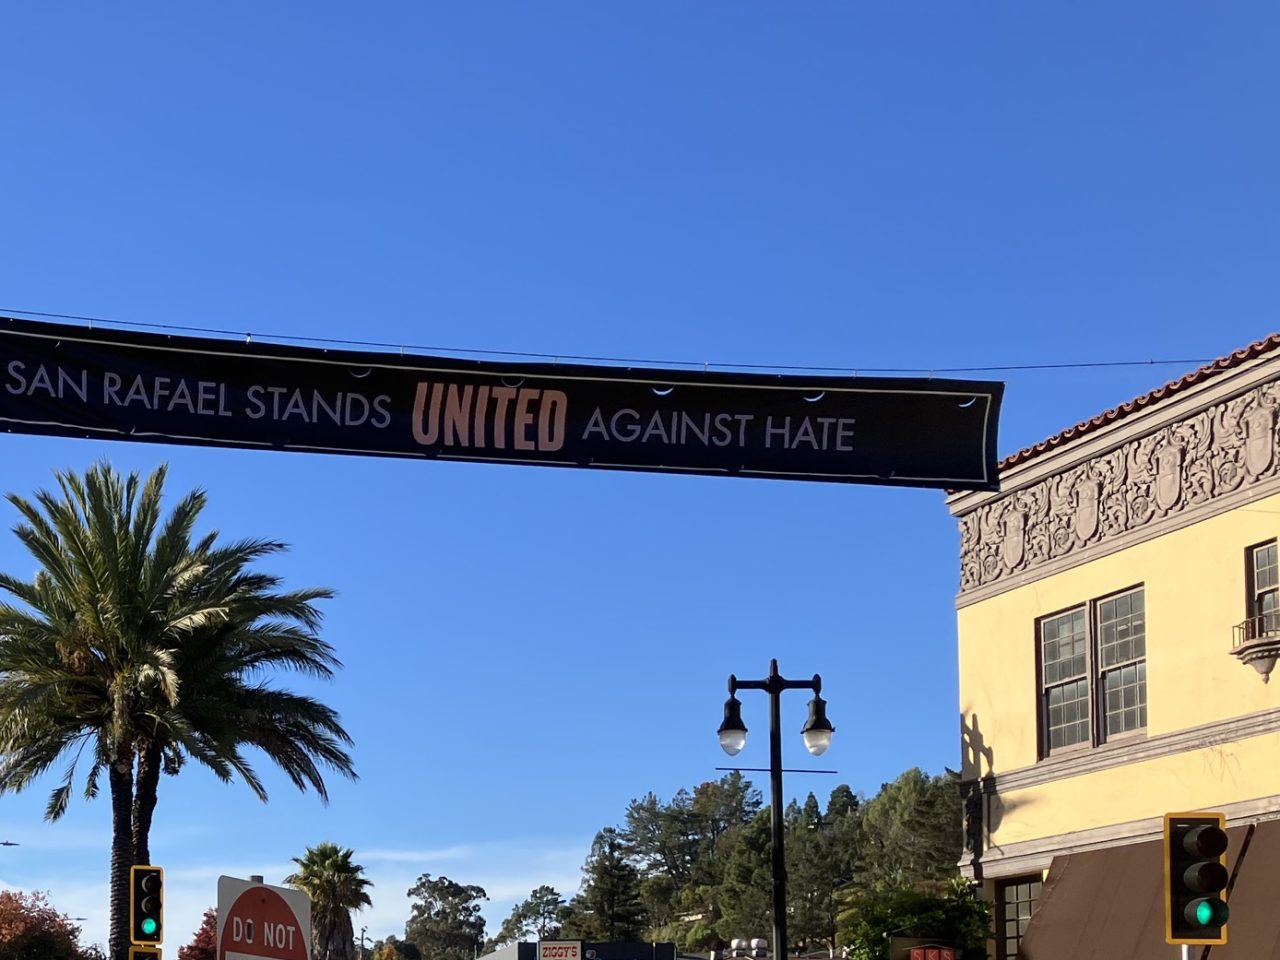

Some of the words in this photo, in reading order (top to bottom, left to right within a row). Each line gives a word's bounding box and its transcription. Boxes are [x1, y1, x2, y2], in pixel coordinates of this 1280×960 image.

[5, 360, 89, 404] SAN
[103, 371, 232, 417] RAFAEL
[245, 385, 392, 429] STANDS
[412, 381, 568, 452] UNITED
[582, 406, 754, 447] AGAINST
[765, 416, 856, 452] HATE
[233, 916, 255, 944] DO
[264, 921, 296, 951] NOT
[543, 945, 577, 957] ZIGGY'S
